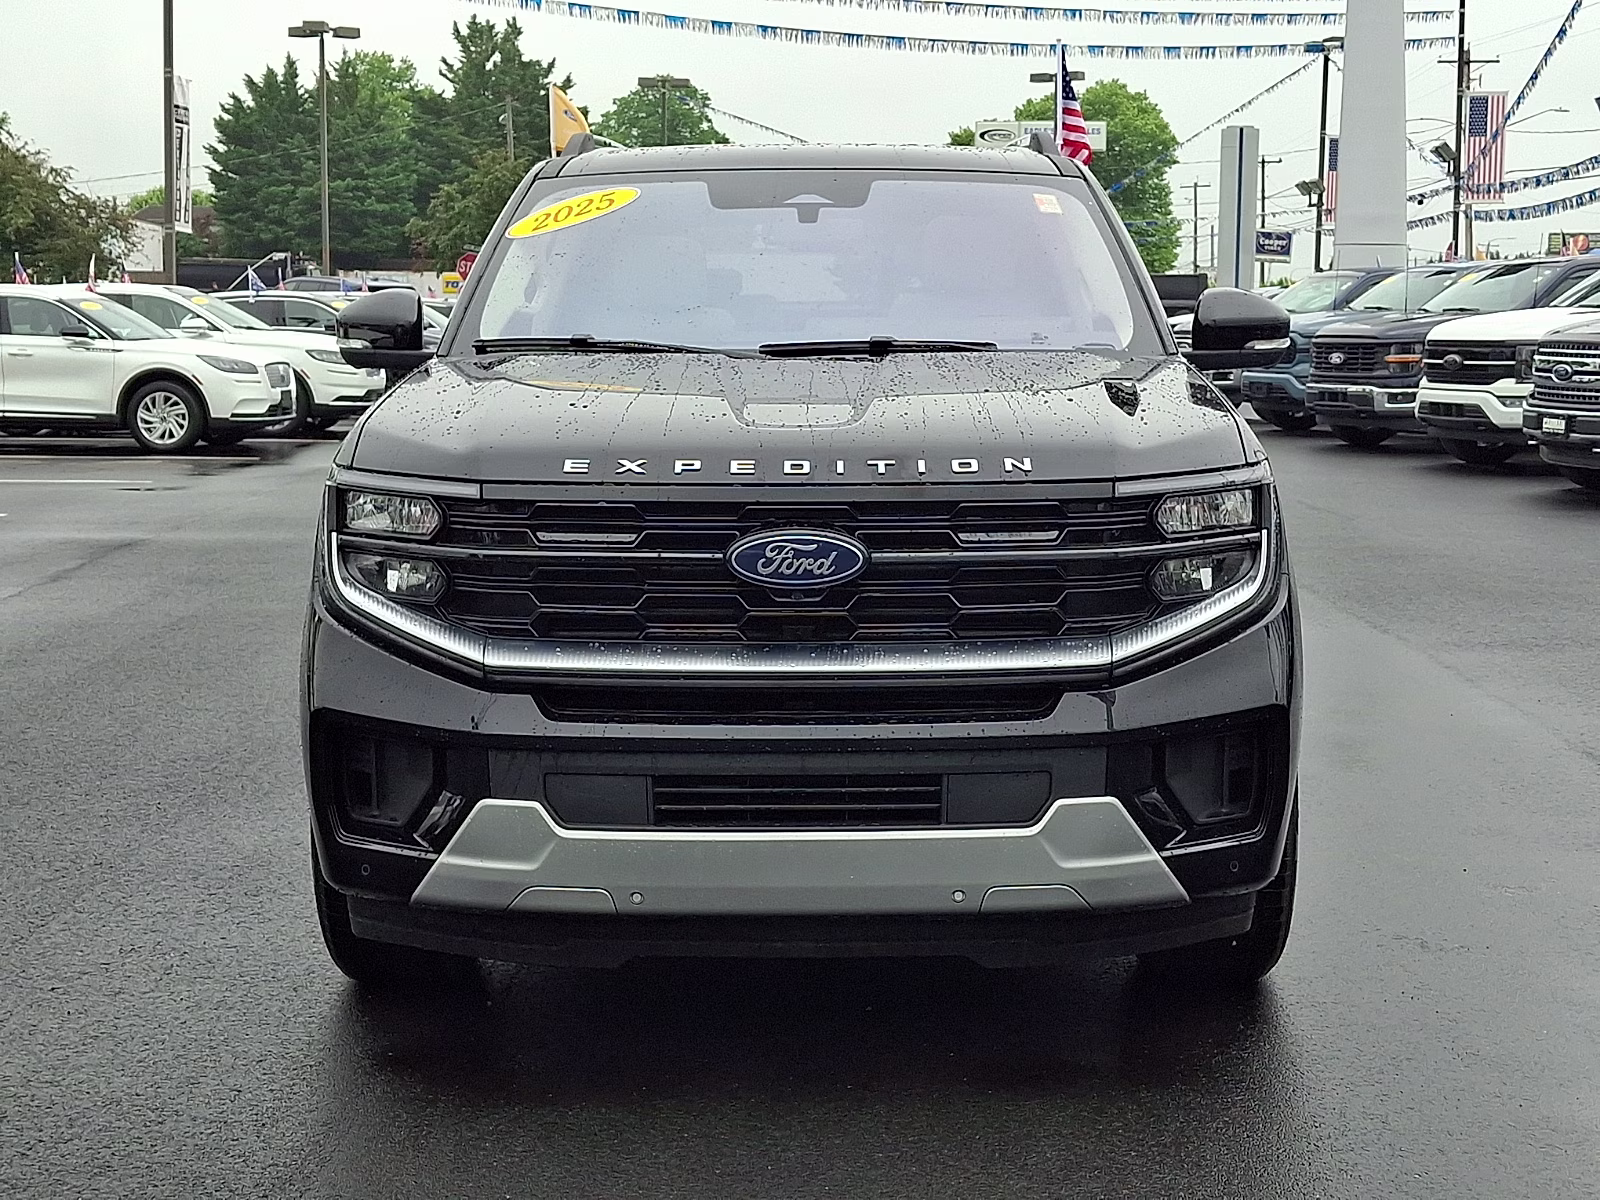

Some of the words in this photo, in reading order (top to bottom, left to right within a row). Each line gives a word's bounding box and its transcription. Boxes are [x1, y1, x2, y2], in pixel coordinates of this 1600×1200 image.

[532, 192, 616, 232] 2025
[459, 260, 472, 273] ST
[562, 457, 1033, 475] EXPEDITION
[757, 542, 838, 576] Ford
